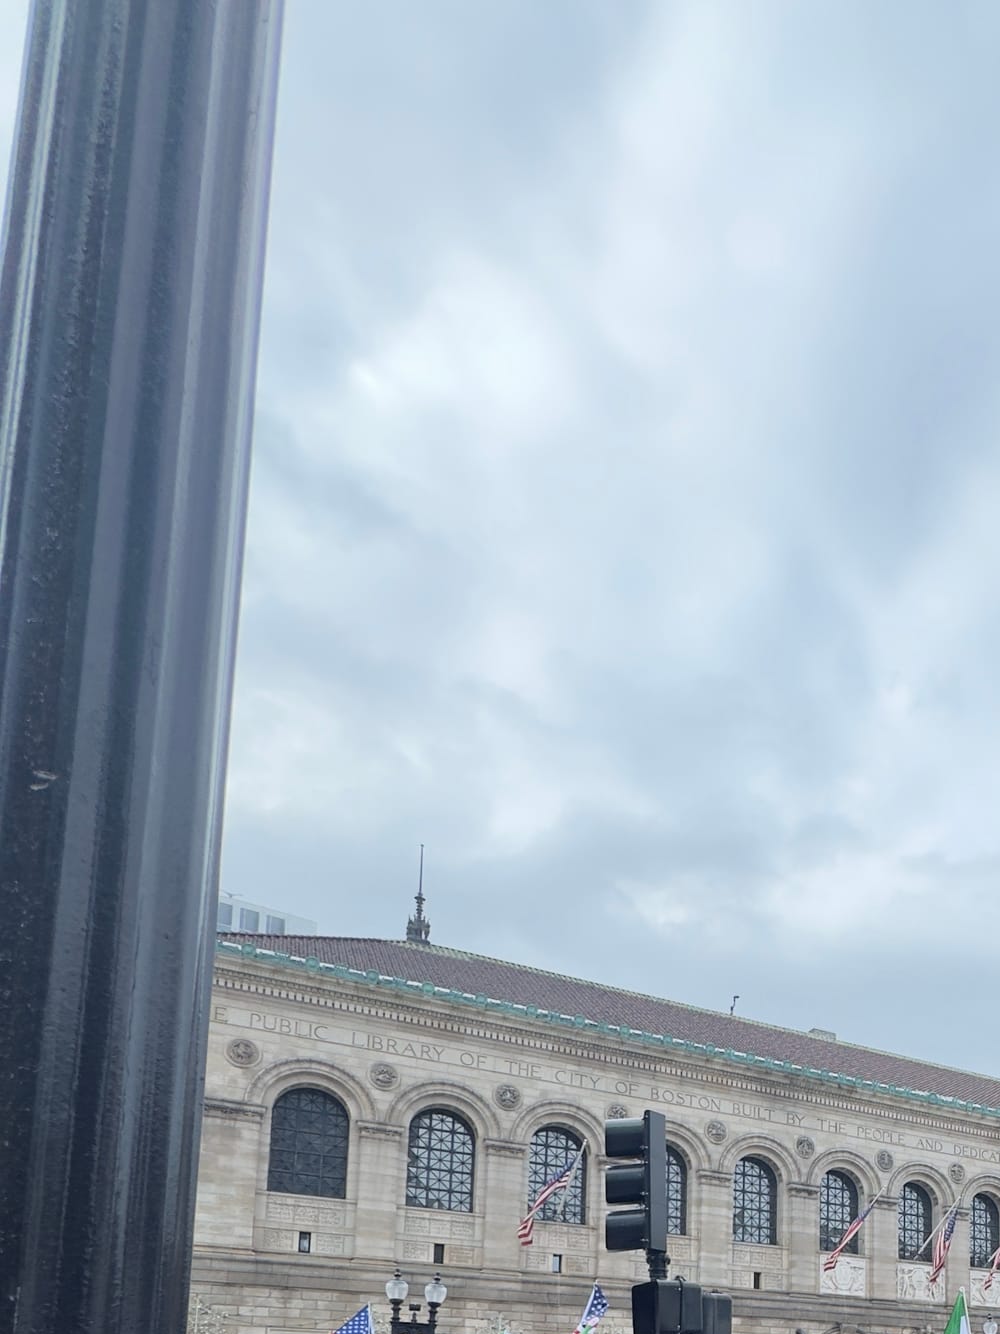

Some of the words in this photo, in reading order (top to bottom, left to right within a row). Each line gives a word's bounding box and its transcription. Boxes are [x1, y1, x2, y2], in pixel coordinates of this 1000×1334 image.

[250, 1013, 329, 1040] PUBLIC
[352, 1031, 445, 1061] LIBRARY
[460, 1052, 488, 1068] OF
[505, 1060, 543, 1079] THE
[555, 1070, 601, 1089] CITY
[615, 1081, 642, 1096] OF
[650, 1087, 722, 1111] BOSTON
[732, 1103, 776, 1121] BUILT
[786, 1111, 805, 1126] BY
[817, 1118, 847, 1134] THE
[857, 1126, 905, 1146] PEOPLE
[916, 1138, 943, 1152] AND
